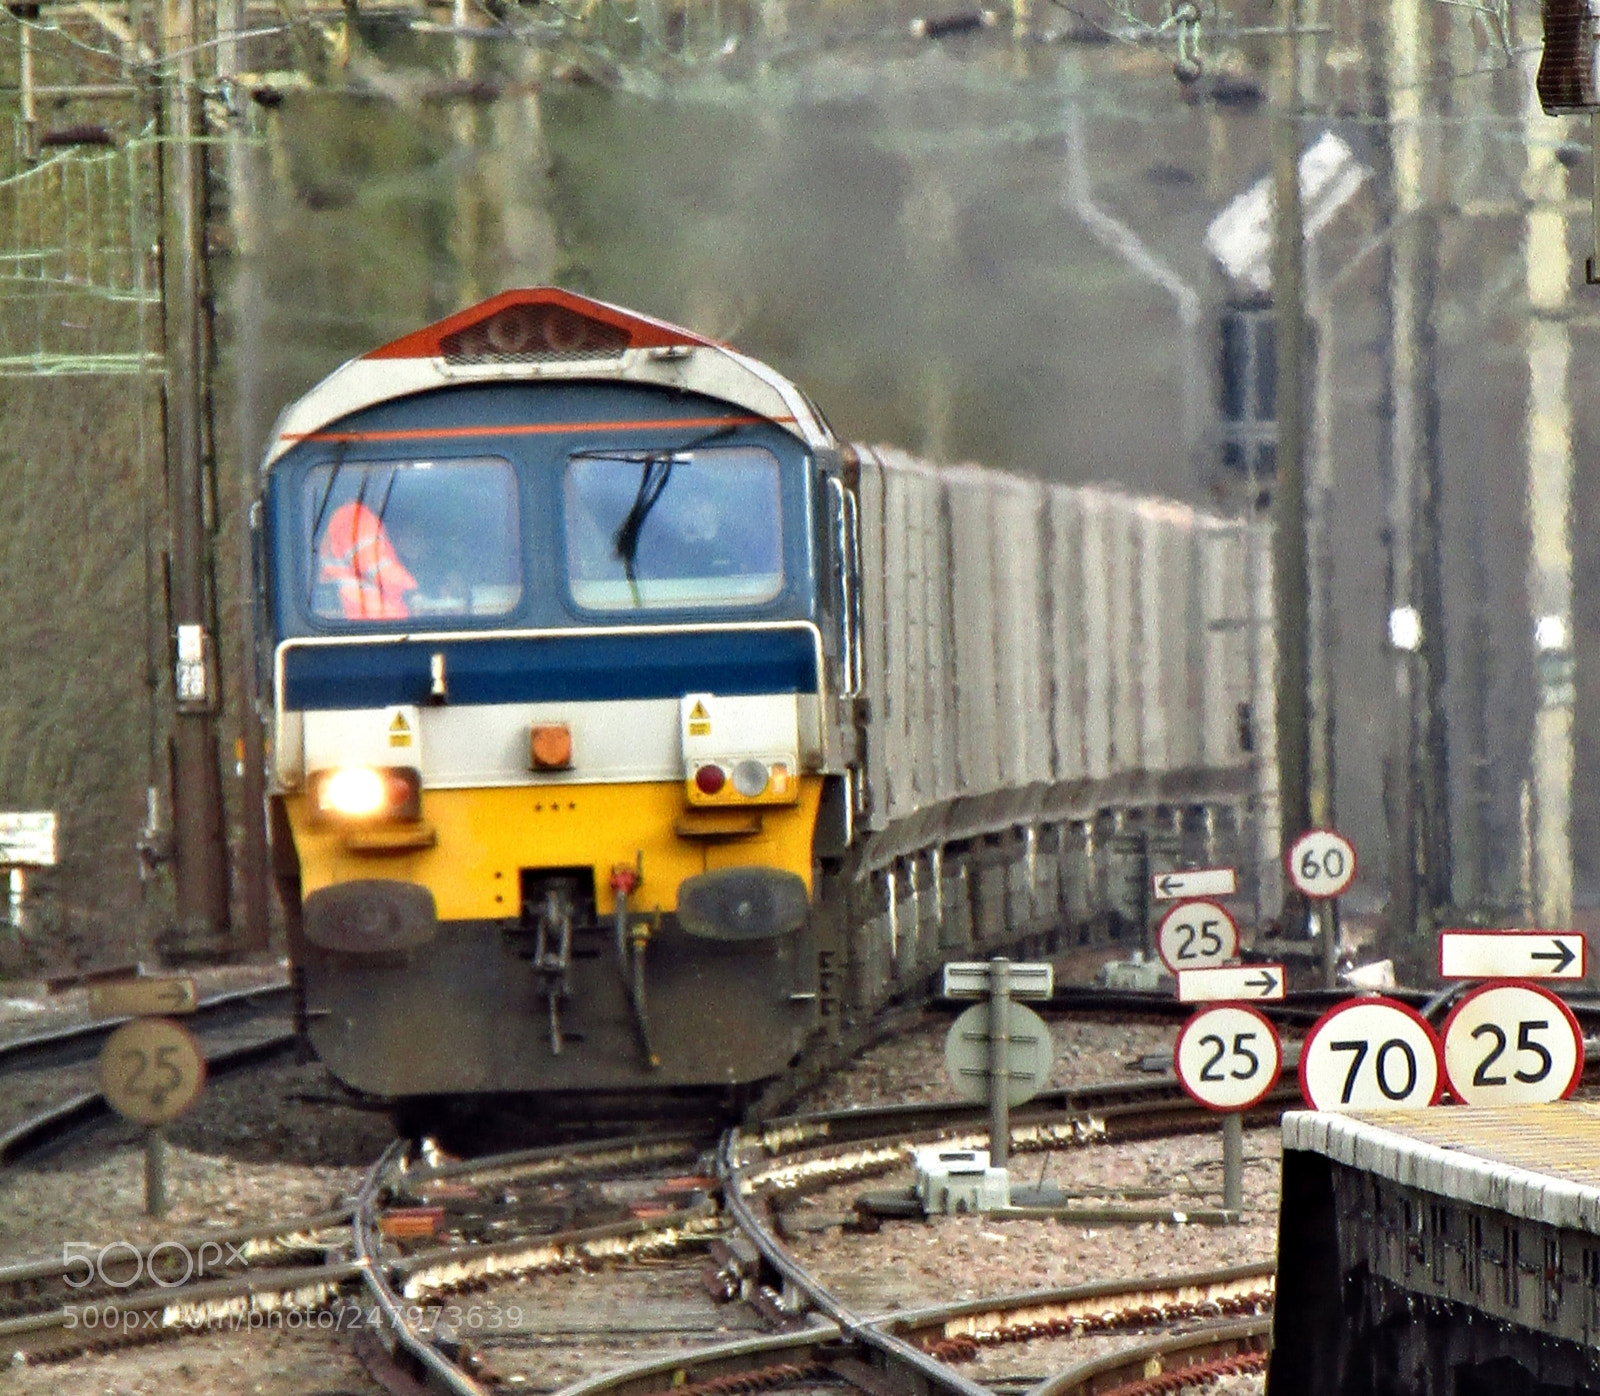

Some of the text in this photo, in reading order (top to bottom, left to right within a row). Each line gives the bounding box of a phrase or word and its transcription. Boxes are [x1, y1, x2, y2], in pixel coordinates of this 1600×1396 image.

[1301, 848, 1345, 880] 60
[1174, 920, 1223, 960] 25
[120, 1045, 182, 1097] 25
[1199, 1032, 1259, 1082] 25
[1329, 1037, 1417, 1105] 70
[1470, 1020, 1553, 1087] 25
